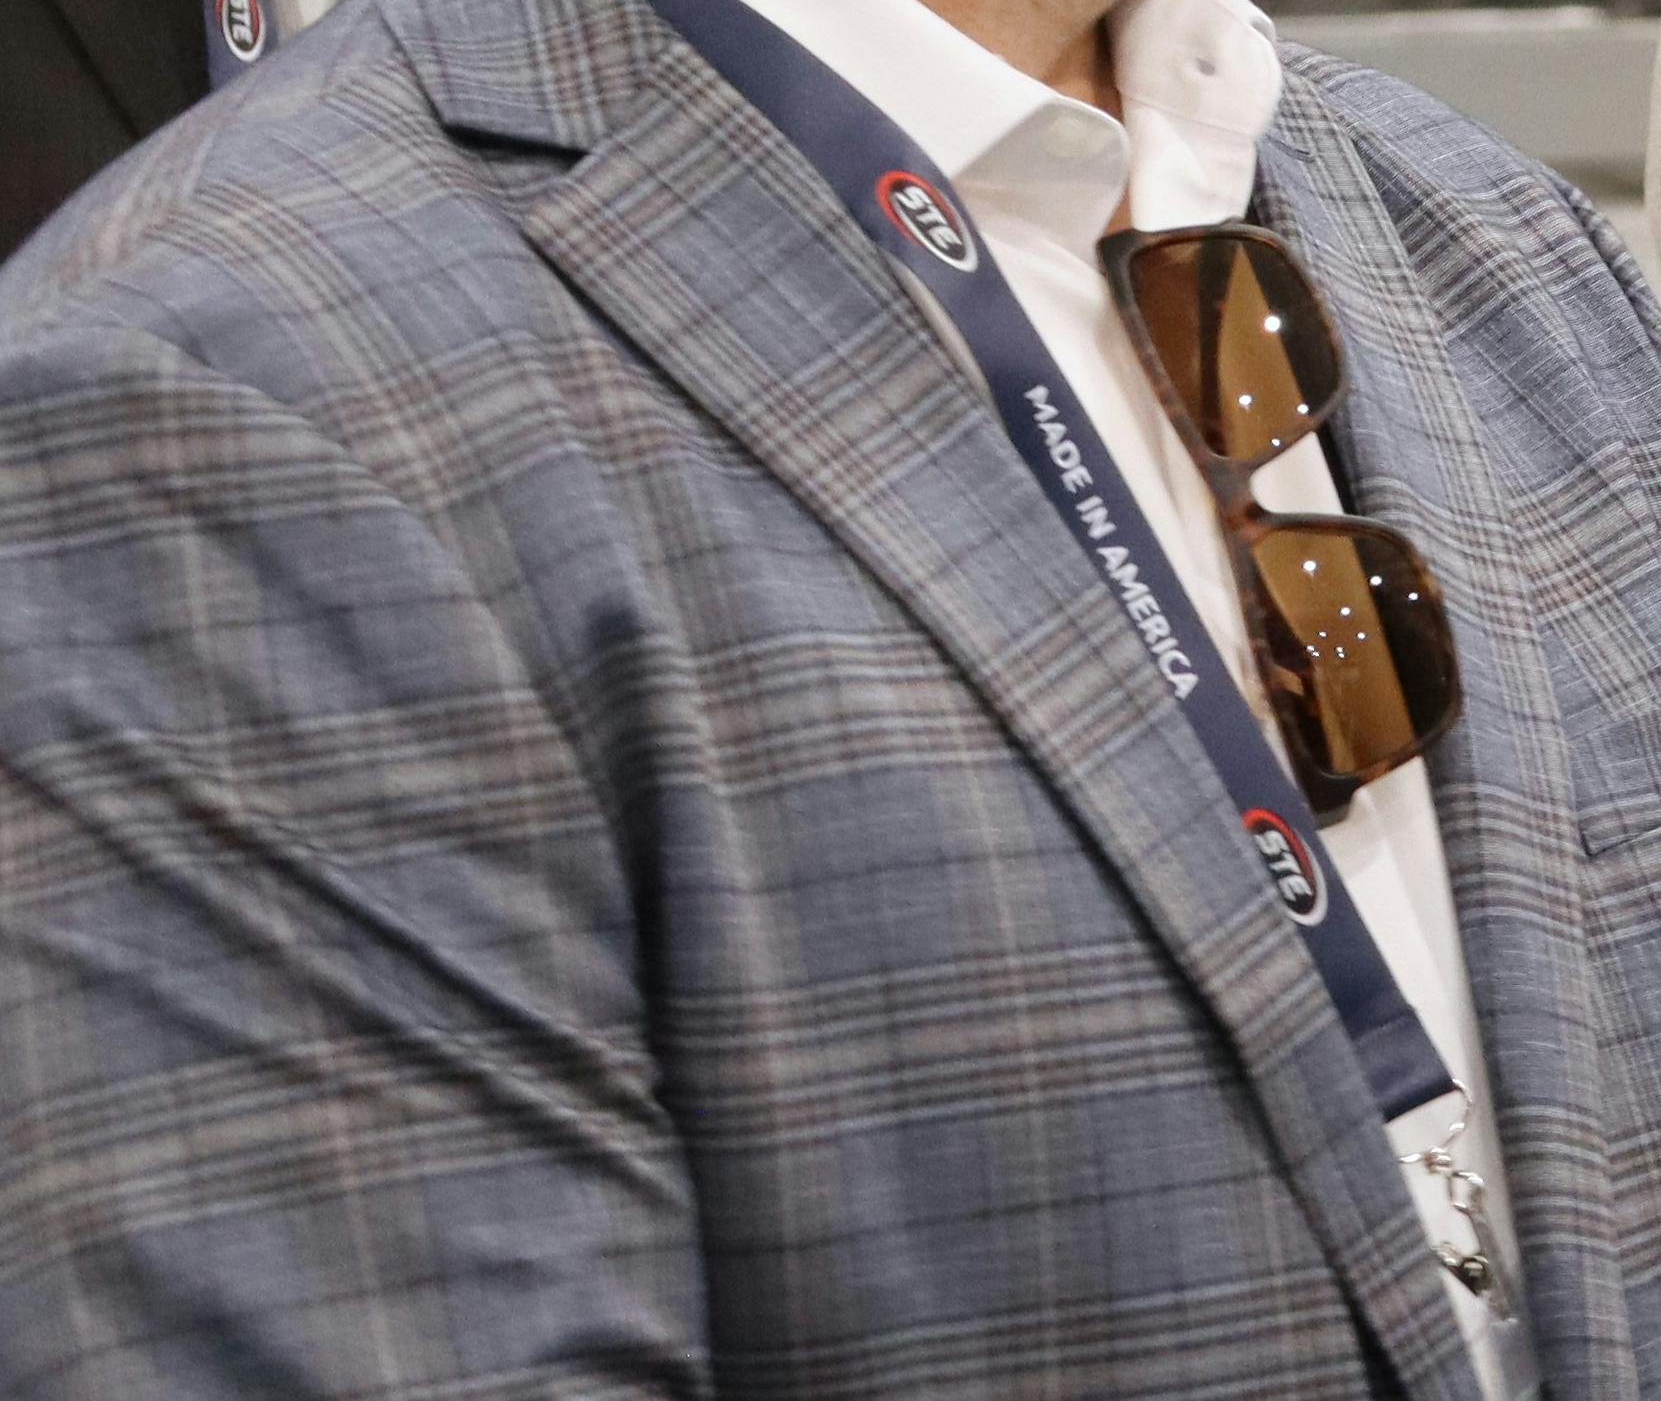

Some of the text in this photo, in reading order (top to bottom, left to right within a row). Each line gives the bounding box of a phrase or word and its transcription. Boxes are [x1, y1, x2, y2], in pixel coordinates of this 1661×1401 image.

[894, 184, 964, 250] STE
[1023, 384, 1200, 701] MADE IN AMERICA
[1253, 830, 1313, 902] STE
